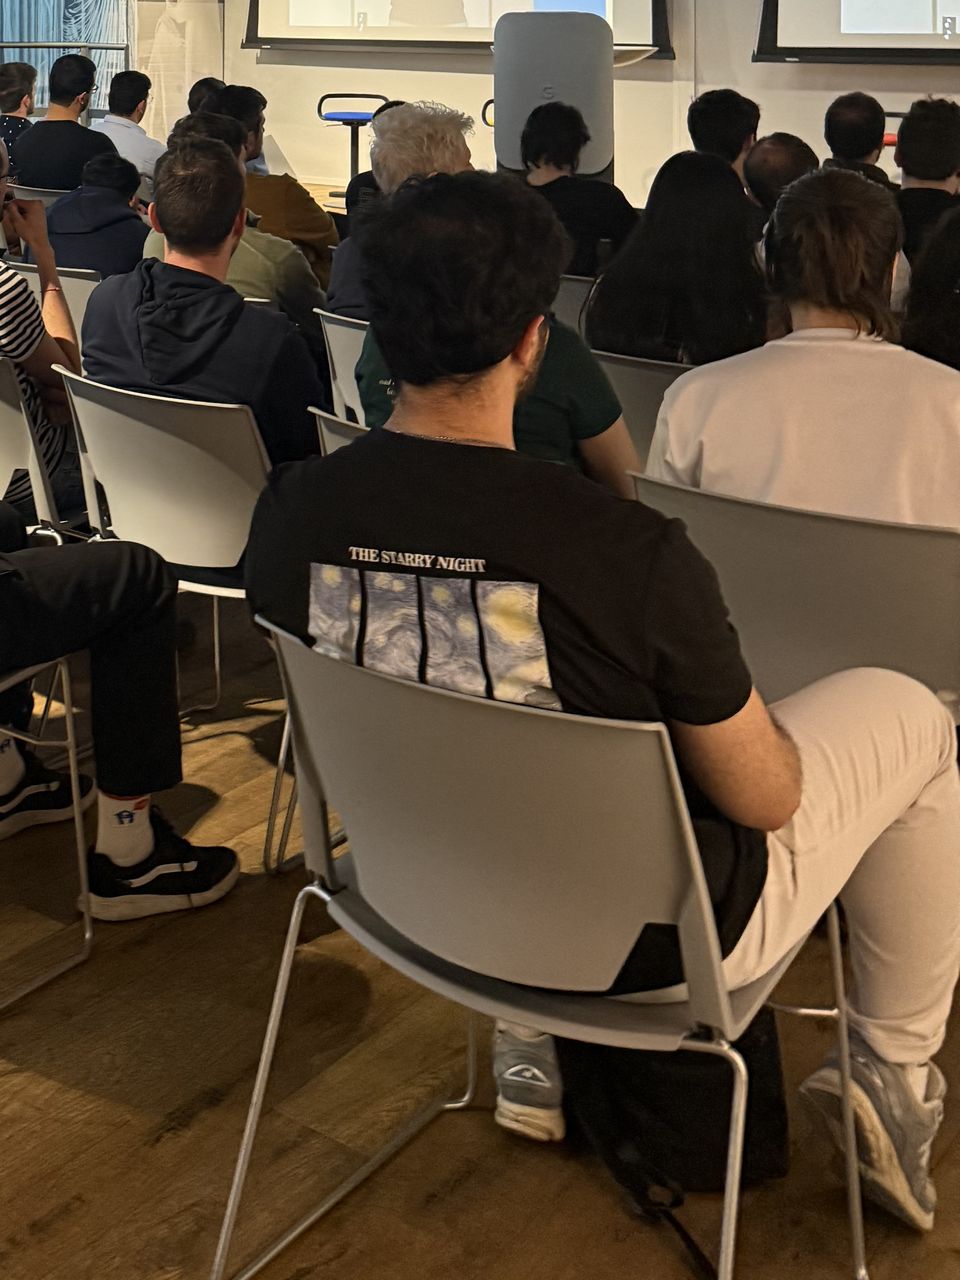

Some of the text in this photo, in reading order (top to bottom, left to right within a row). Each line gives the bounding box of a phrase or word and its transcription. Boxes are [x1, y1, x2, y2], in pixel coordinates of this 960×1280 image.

[348, 546, 487, 573] THE STARRY NIGHT
